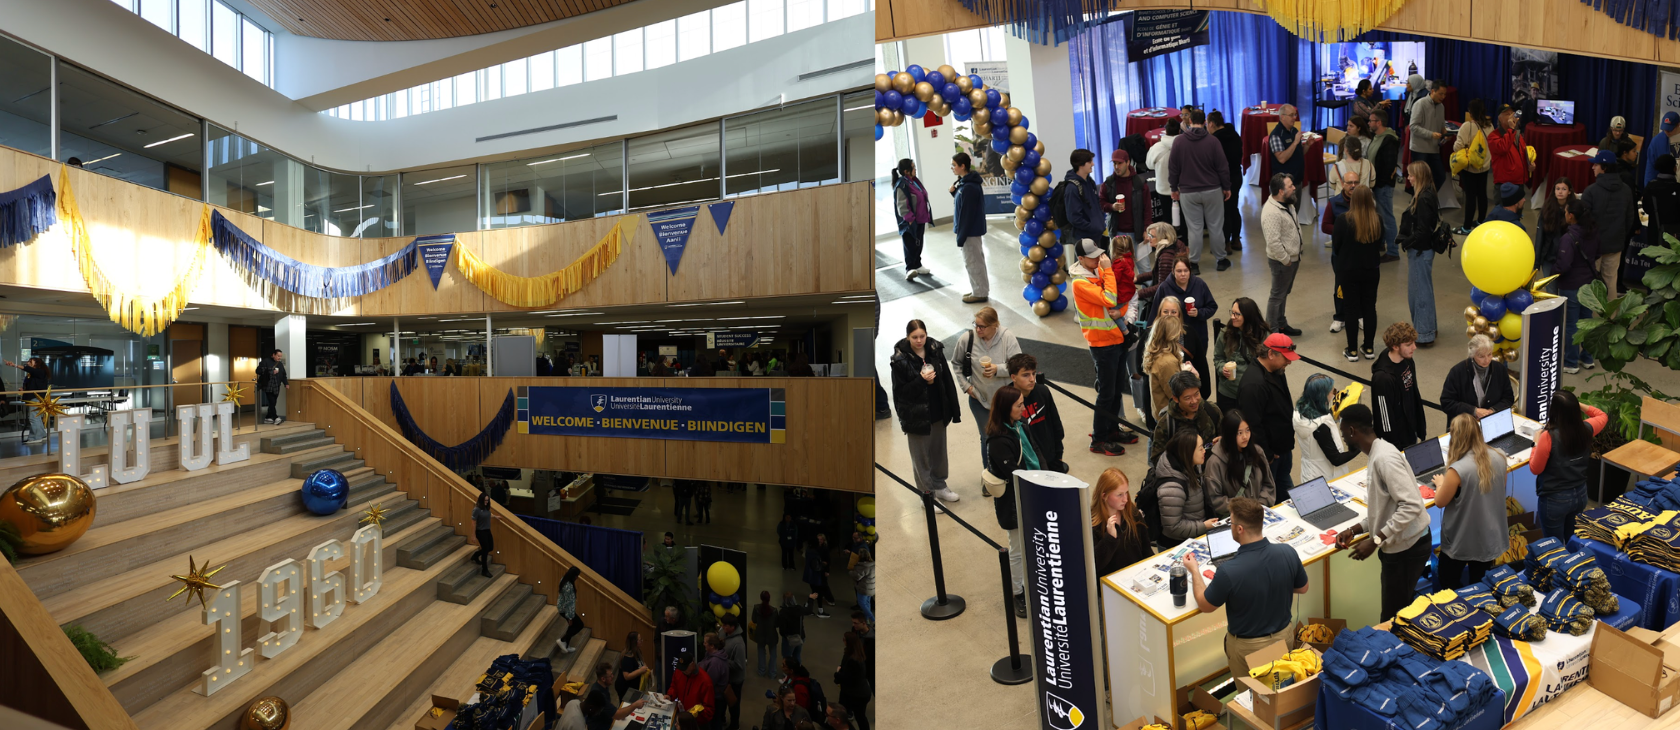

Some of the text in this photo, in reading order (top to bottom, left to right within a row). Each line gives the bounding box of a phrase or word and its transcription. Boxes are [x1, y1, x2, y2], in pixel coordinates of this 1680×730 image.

[532, 415, 766, 433] WELCOME BIENVENUE BIINDIGEN
[202, 523, 383, 697] 1960
